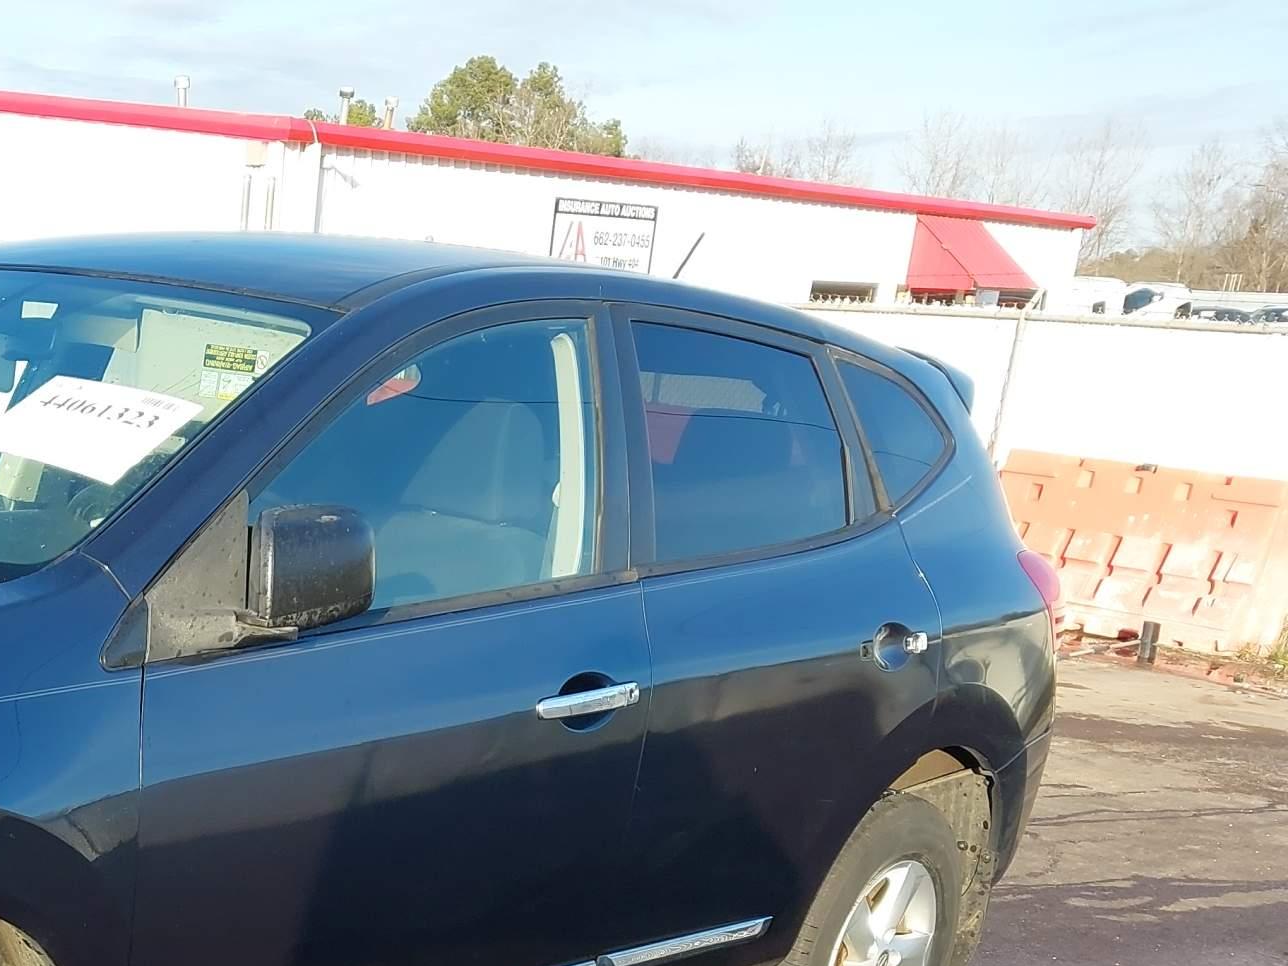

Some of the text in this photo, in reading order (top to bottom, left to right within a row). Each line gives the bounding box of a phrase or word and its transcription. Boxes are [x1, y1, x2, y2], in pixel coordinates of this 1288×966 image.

[559, 199, 655, 219] INSURANCE AUTO AUCTIONS
[39, 394, 160, 429] 44061323
